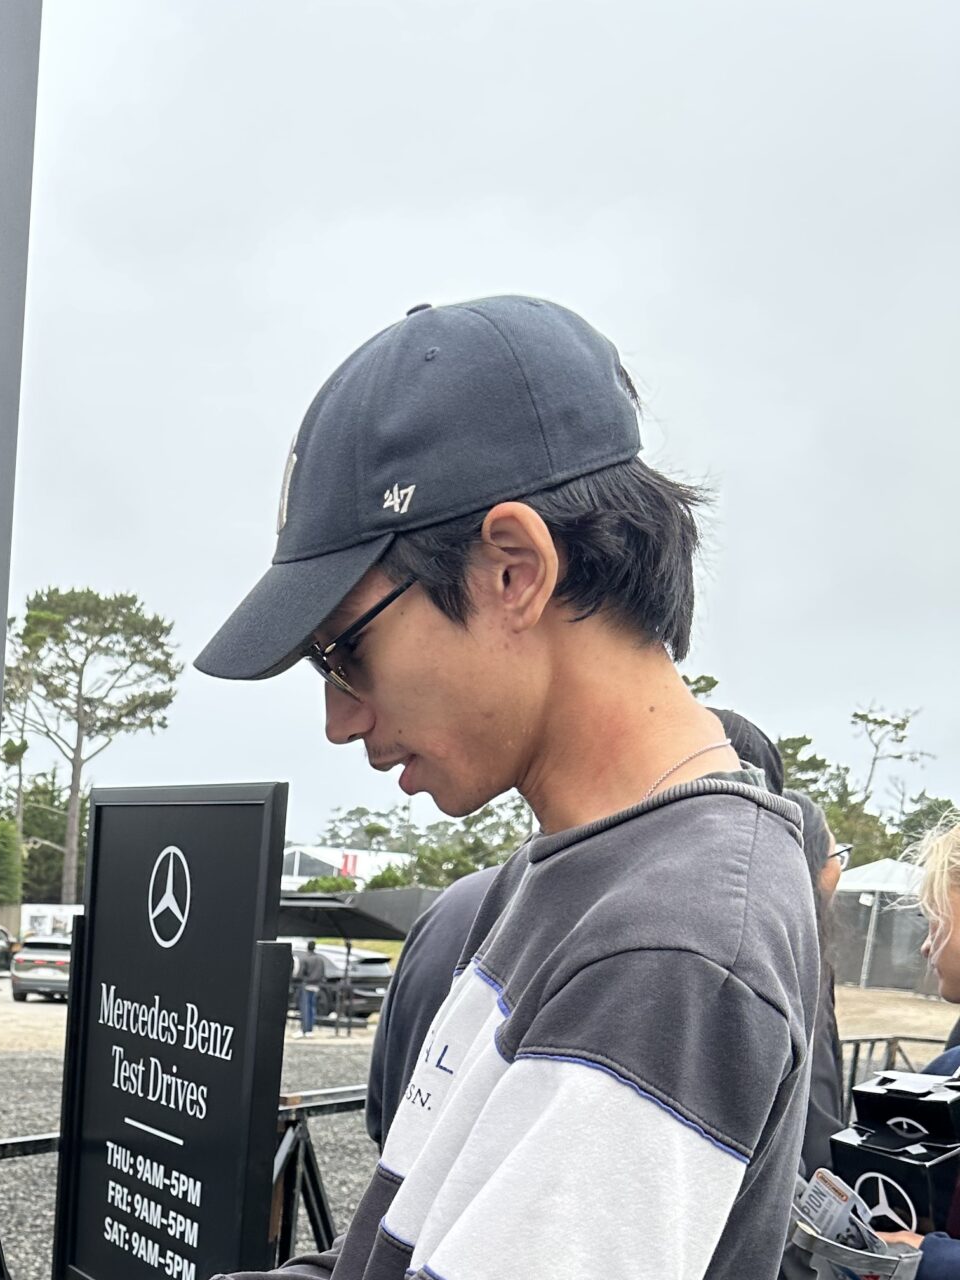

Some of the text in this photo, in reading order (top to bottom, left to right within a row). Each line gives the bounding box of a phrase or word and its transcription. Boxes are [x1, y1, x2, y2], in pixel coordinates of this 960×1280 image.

[98, 982, 234, 1061] Mercedes-Benz
[111, 1044, 208, 1120] Test Drives
[105, 1140, 202, 1208] THU: 9AM-5PM
[103, 1216, 130, 1251] SAT:
[107, 1180, 199, 1249] FRI: 9AM-5PM
